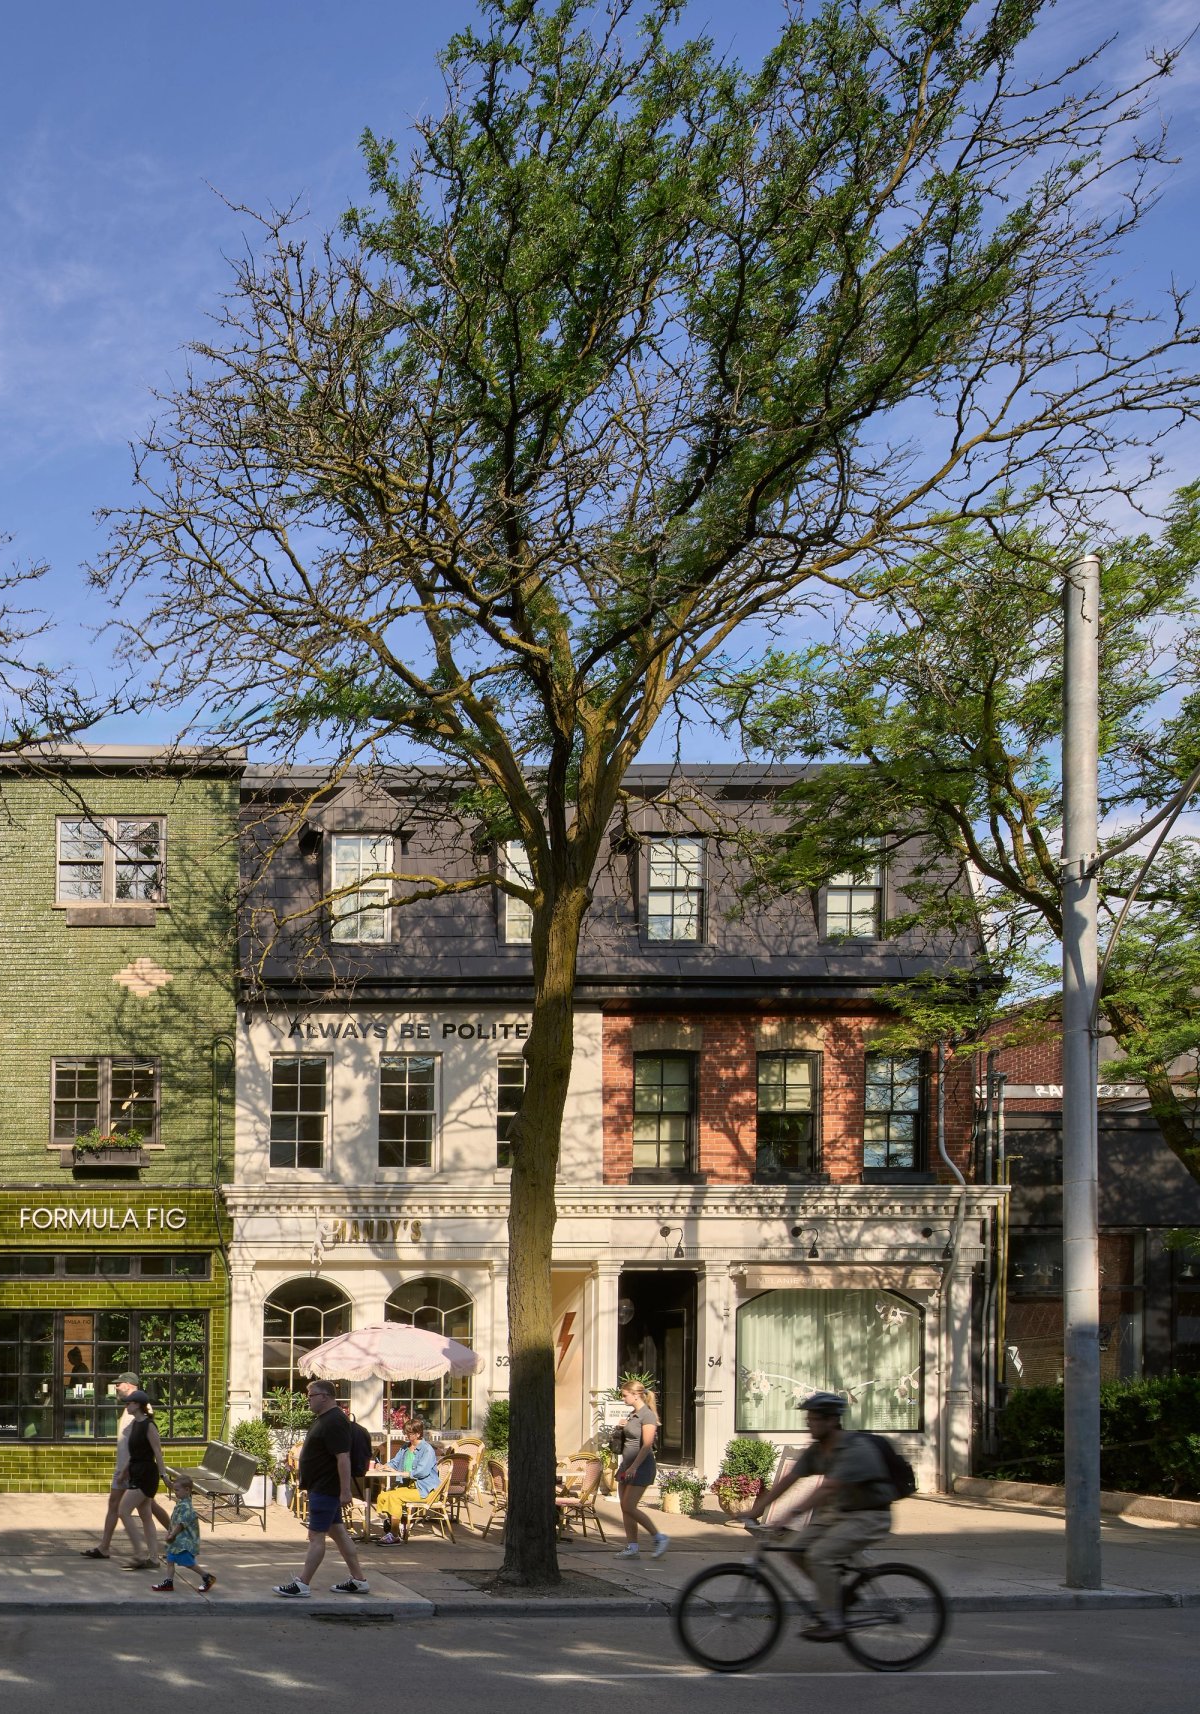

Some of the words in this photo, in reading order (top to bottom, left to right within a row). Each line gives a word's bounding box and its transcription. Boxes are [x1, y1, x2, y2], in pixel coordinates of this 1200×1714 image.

[288, 1022, 388, 1039] ALWAYS
[400, 1023, 431, 1039] BE
[442, 1023, 529, 1040] POLITE
[20, 1207, 140, 1230] FORMULA
[146, 1207, 187, 1230] FIG
[332, 1219, 422, 1244] MANDY'S
[495, 1356, 510, 1368] 52
[707, 1355, 723, 1368] 54
